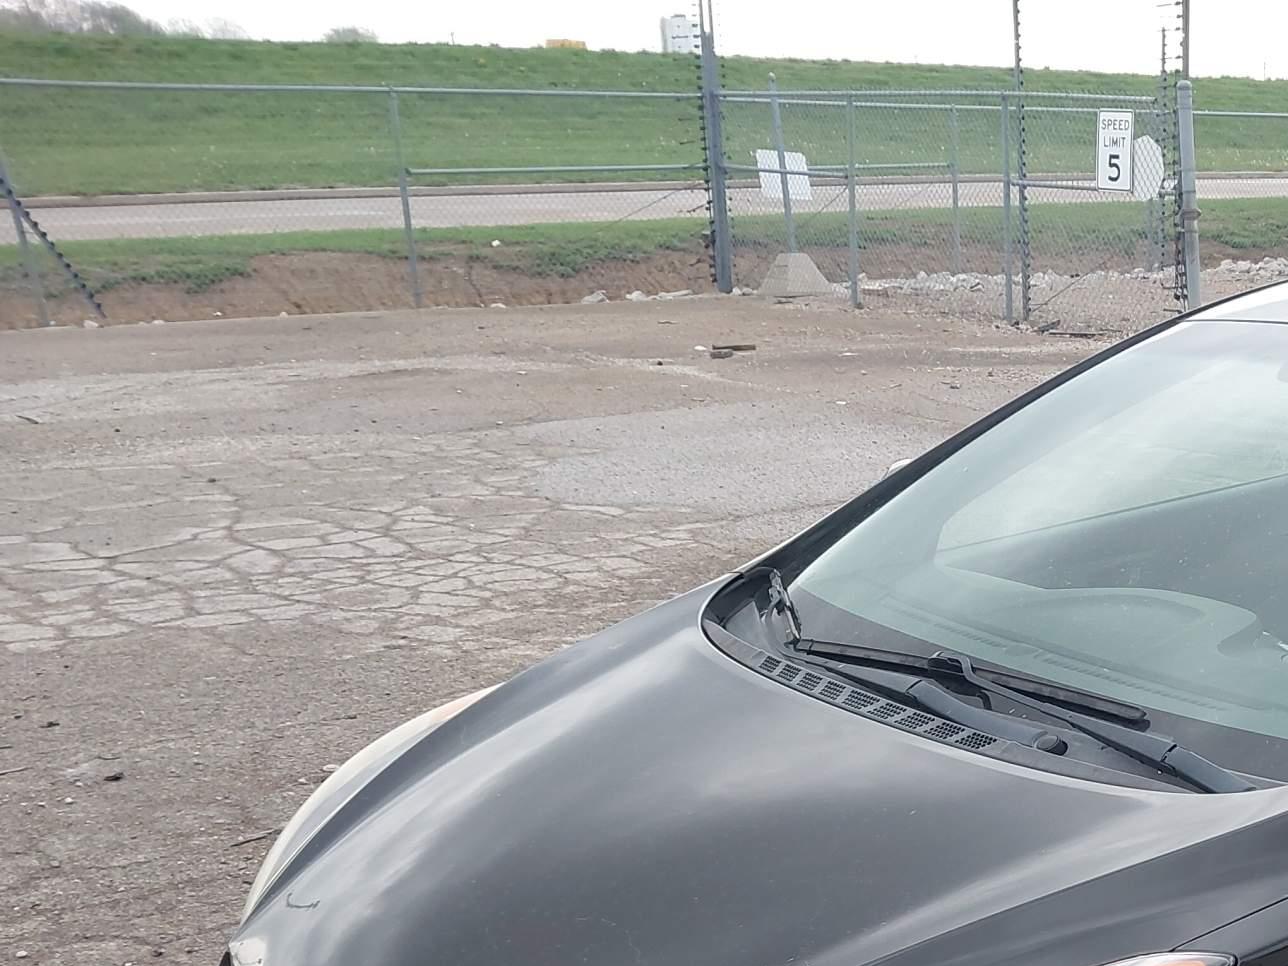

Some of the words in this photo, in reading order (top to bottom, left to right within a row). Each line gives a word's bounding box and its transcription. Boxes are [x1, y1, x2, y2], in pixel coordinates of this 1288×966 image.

[1102, 119, 1129, 130] SPEED
[1103, 137, 1126, 148] LIMIT
[1107, 154, 1121, 182] 5
